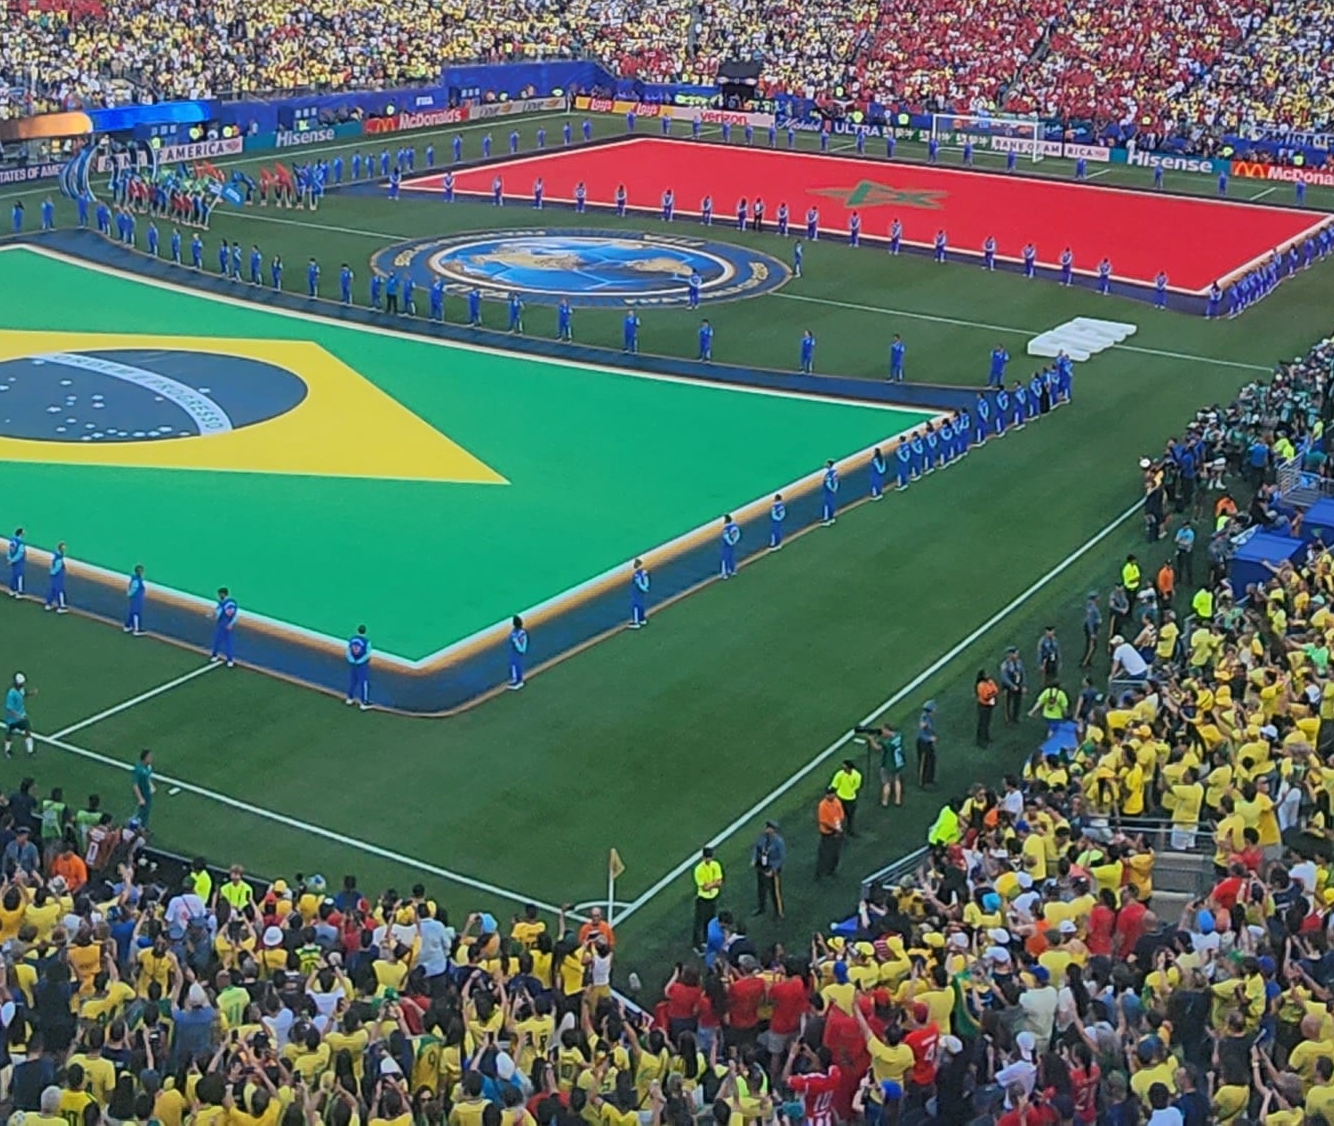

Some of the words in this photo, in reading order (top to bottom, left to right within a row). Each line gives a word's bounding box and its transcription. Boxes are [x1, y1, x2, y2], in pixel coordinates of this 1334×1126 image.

[399, 109, 462, 128] McDonald's
[700, 111, 748, 125] verizon
[276, 128, 335, 148] Hisense
[834, 122, 881, 137] ULTRA
[166, 141, 224, 161] AMERICA
[1044, 144, 1095, 157] AMRICA
[1127, 150, 1213, 173] Hisense
[27, 165, 41, 178] OF
